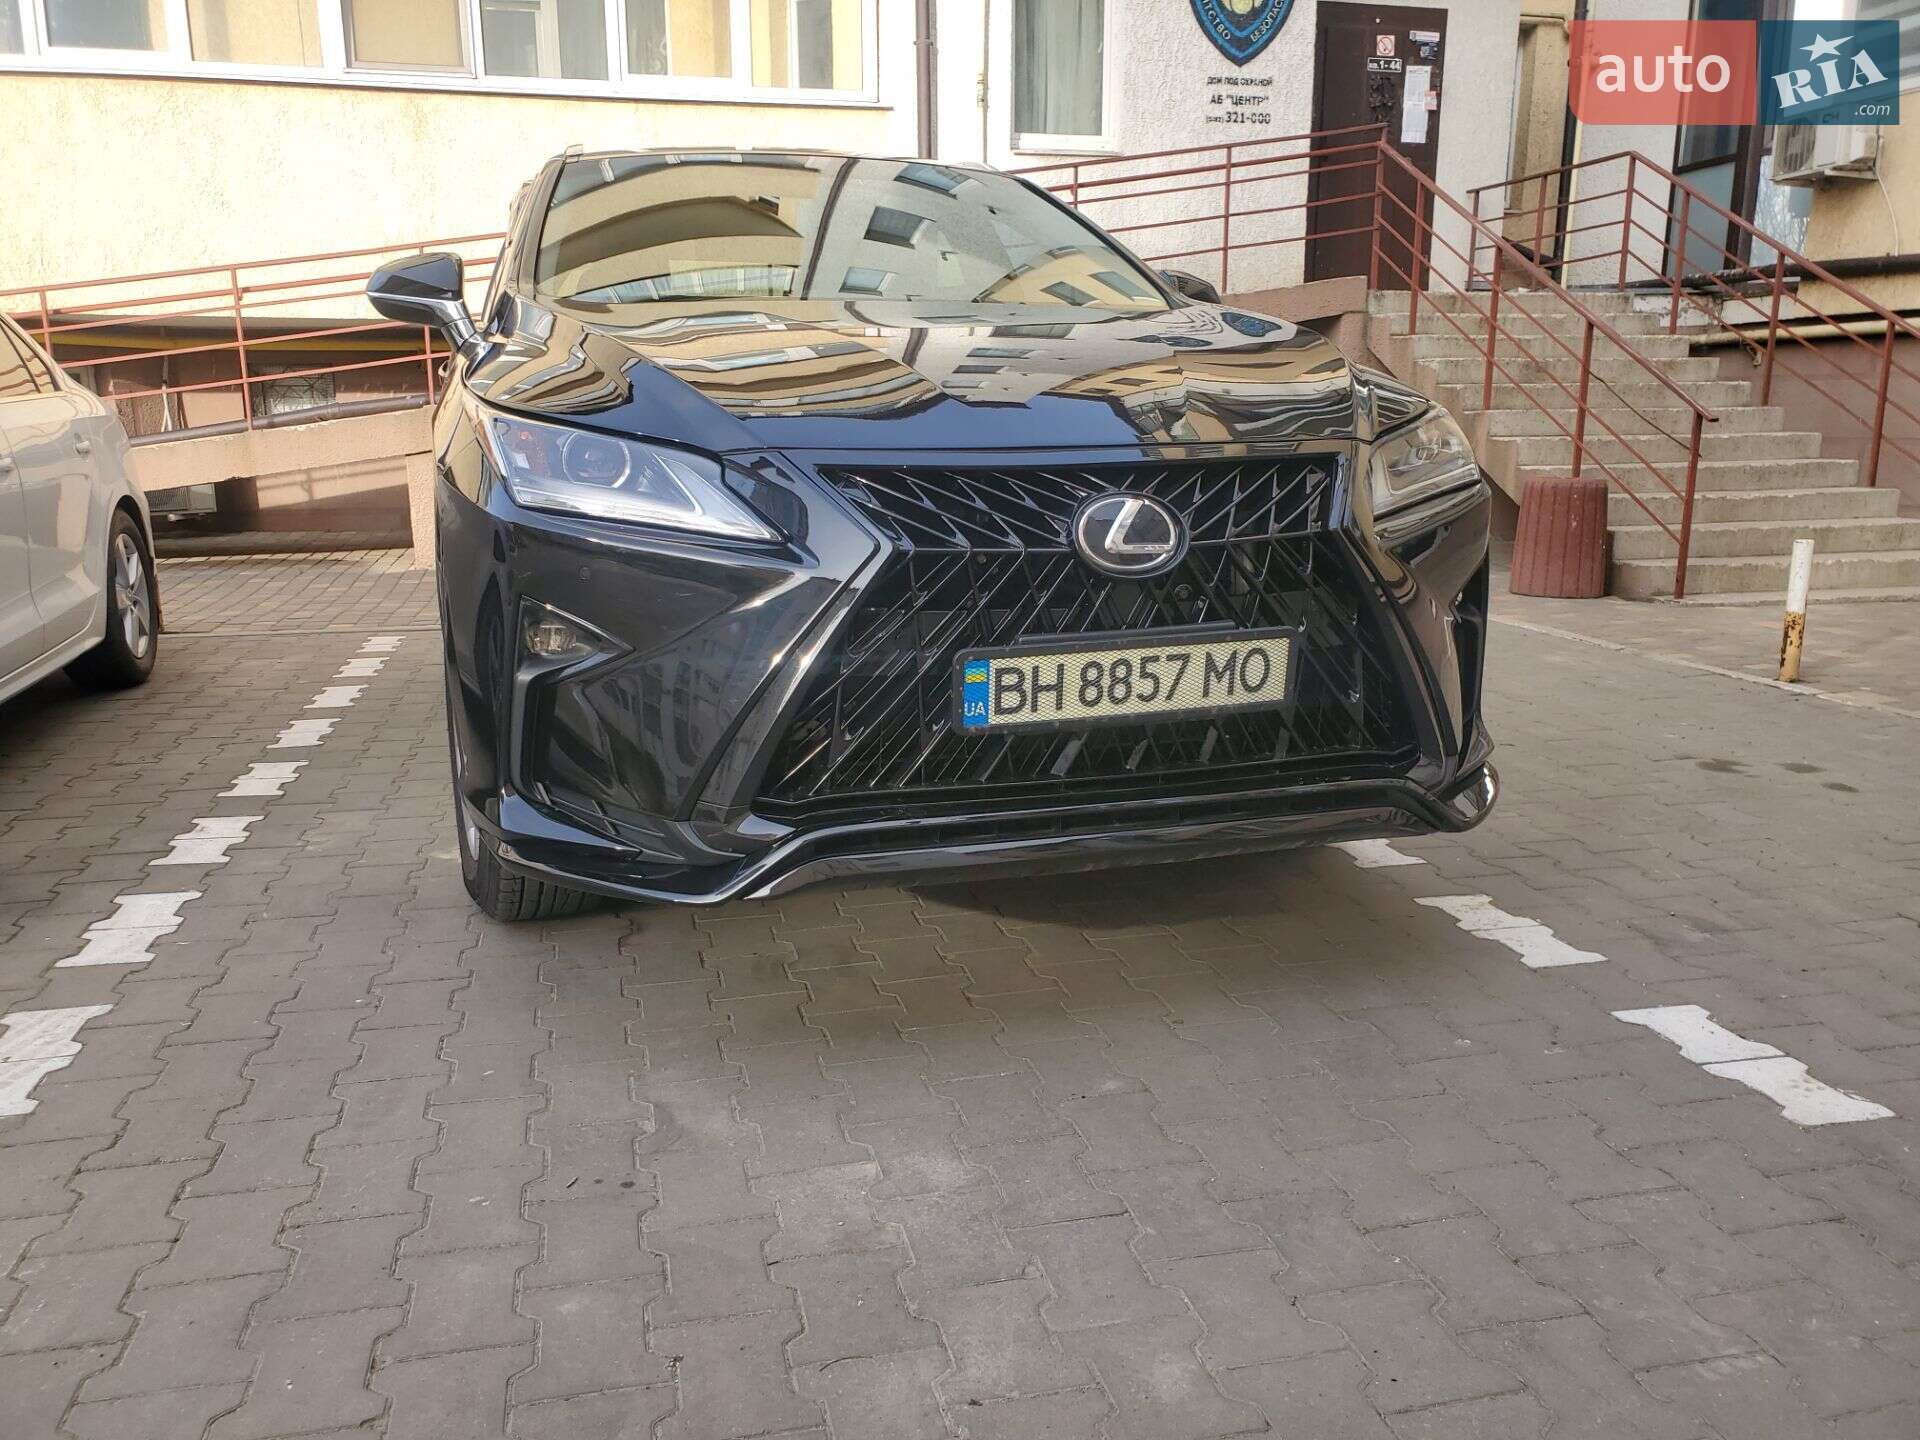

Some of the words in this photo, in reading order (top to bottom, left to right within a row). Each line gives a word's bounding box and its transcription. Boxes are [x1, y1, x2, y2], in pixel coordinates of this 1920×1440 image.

[1209, 94, 1223, 104] АБ
[1078, 653, 1192, 708] 8857
[964, 702, 986, 717] UA
